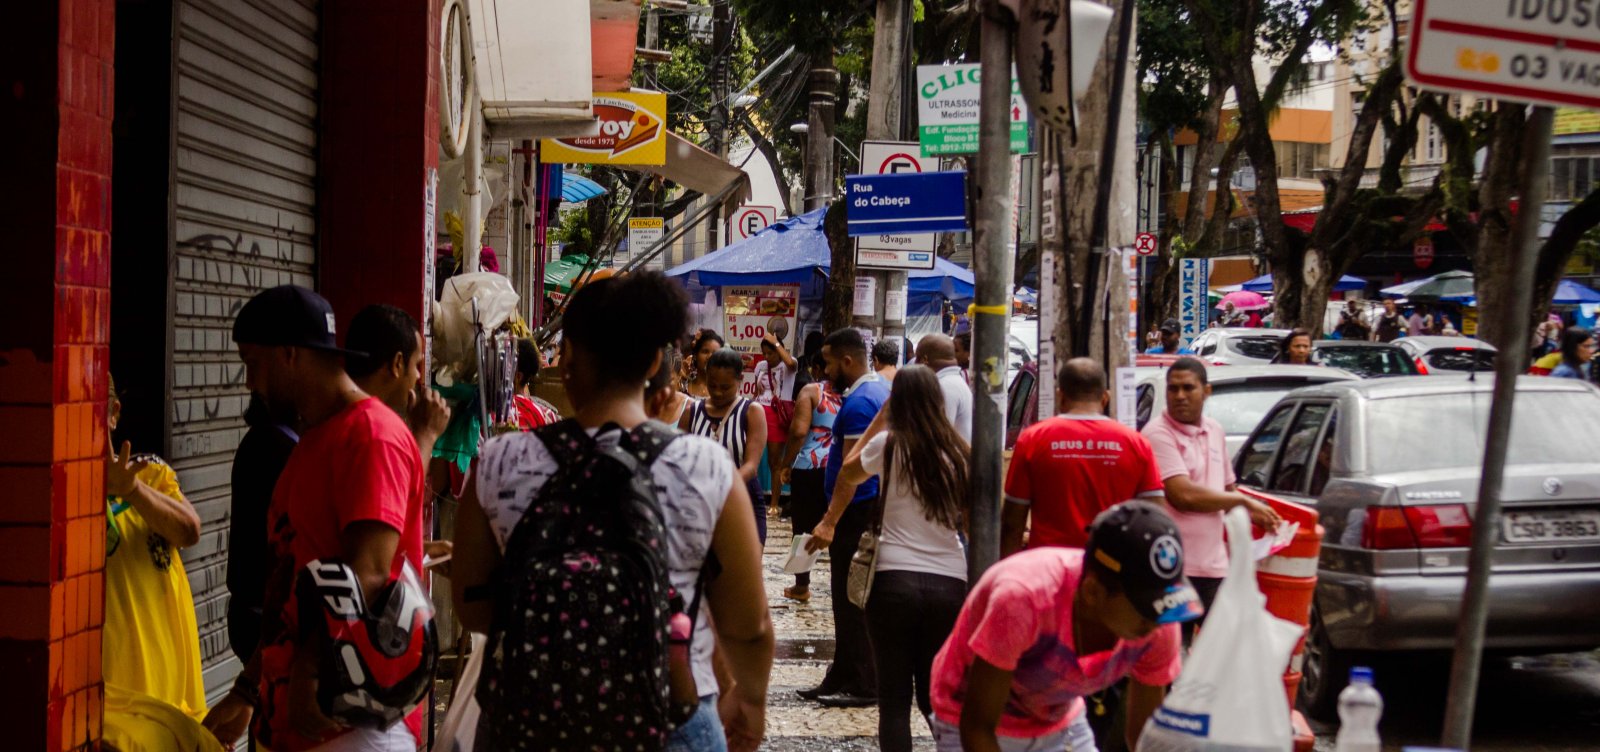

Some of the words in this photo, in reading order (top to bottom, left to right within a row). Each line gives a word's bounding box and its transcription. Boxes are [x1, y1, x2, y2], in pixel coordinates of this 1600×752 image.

[1507, 0, 1600, 28] IDOS
[1510, 54, 1547, 79] 03
[941, 110, 976, 119] Medicina
[575, 137, 596, 145] desde
[598, 137, 614, 145] 1975
[853, 183, 873, 192] Rua
[854, 197, 868, 207] do
[870, 195, 910, 207] Cabeça
[631, 220, 661, 228] ATENÇÃO
[730, 325, 765, 340] 1,00
[1051, 440, 1083, 450] DEUS
[1086, 438, 1095, 450] É
[1097, 440, 1123, 452] FIEL
